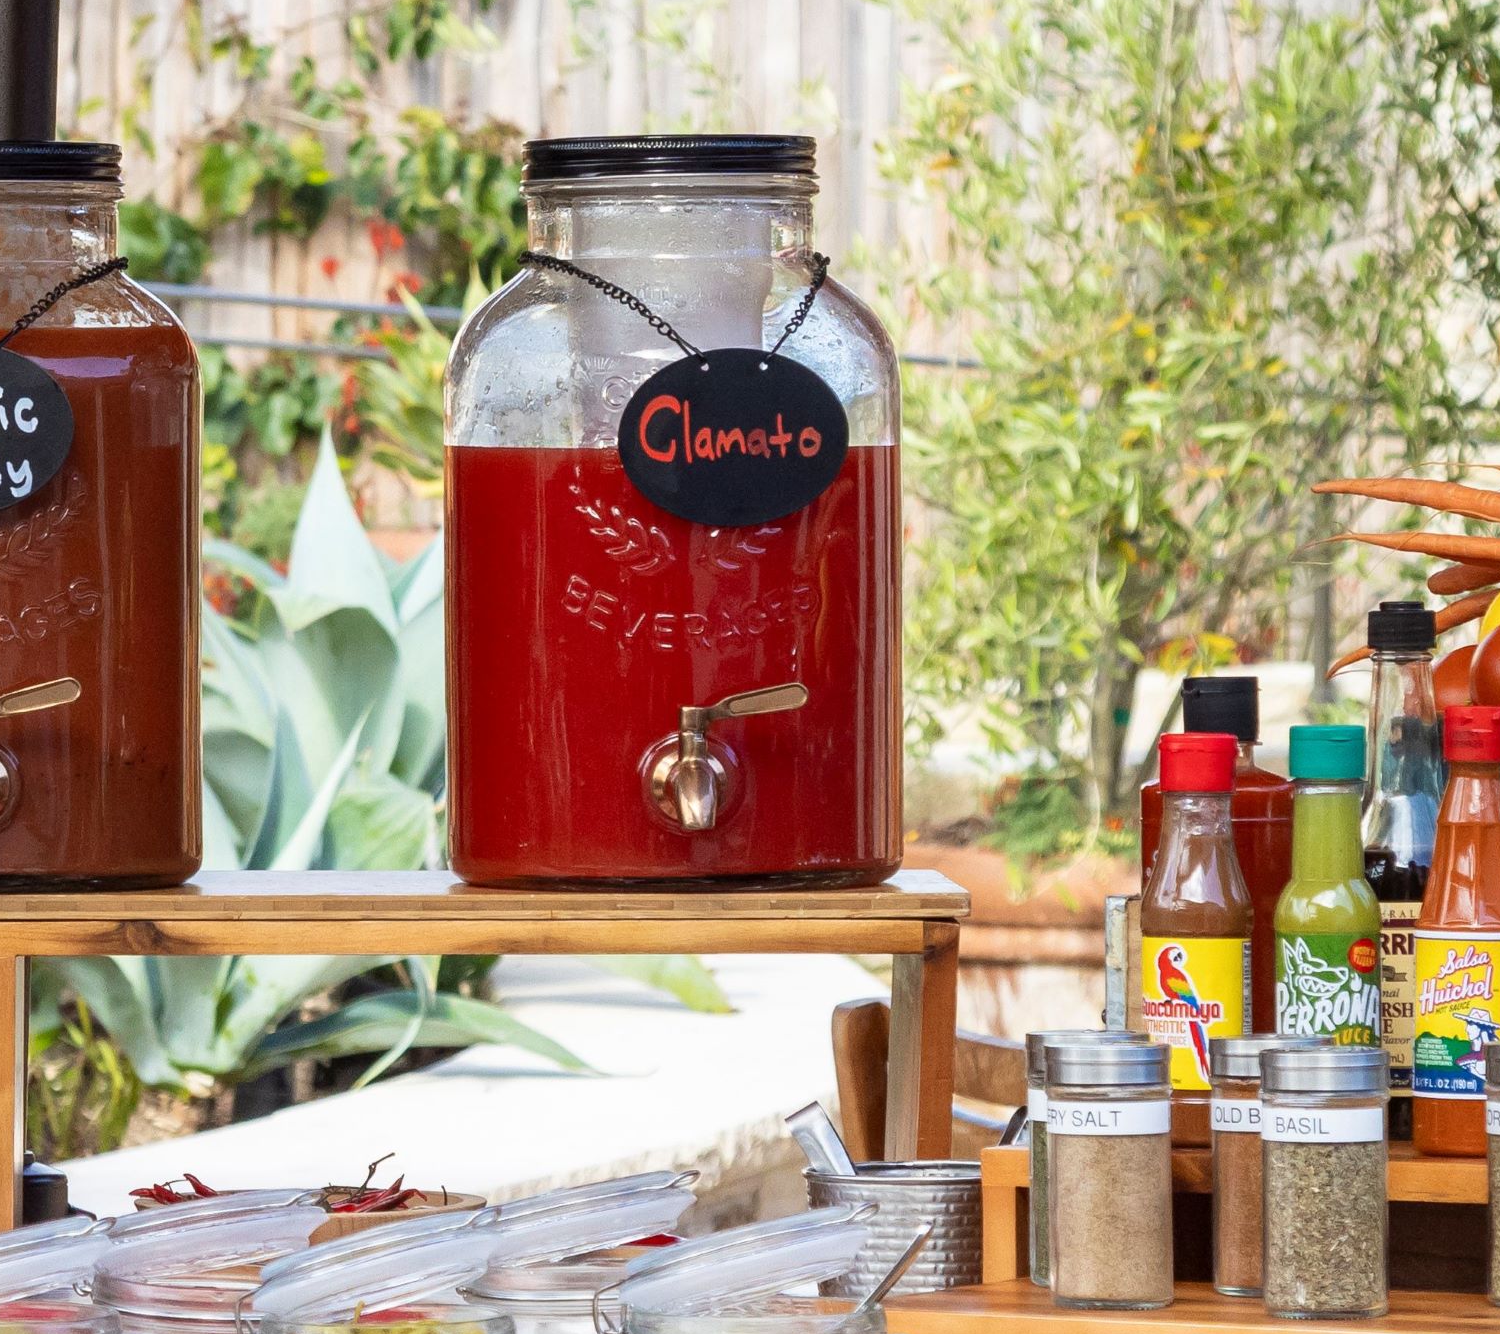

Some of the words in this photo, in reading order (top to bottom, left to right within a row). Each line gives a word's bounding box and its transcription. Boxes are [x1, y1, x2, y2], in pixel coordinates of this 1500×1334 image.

[637, 394, 822, 465] Clamato
[1438, 945, 1490, 979] Salsa
[1419, 965, 1493, 1015] Huichol
[1276, 982, 1381, 1037] PERRONA
[1071, 1110, 1122, 1128] SALT
[1215, 1106, 1241, 1125] OLD
[1275, 1117, 1330, 1136] BASIL
